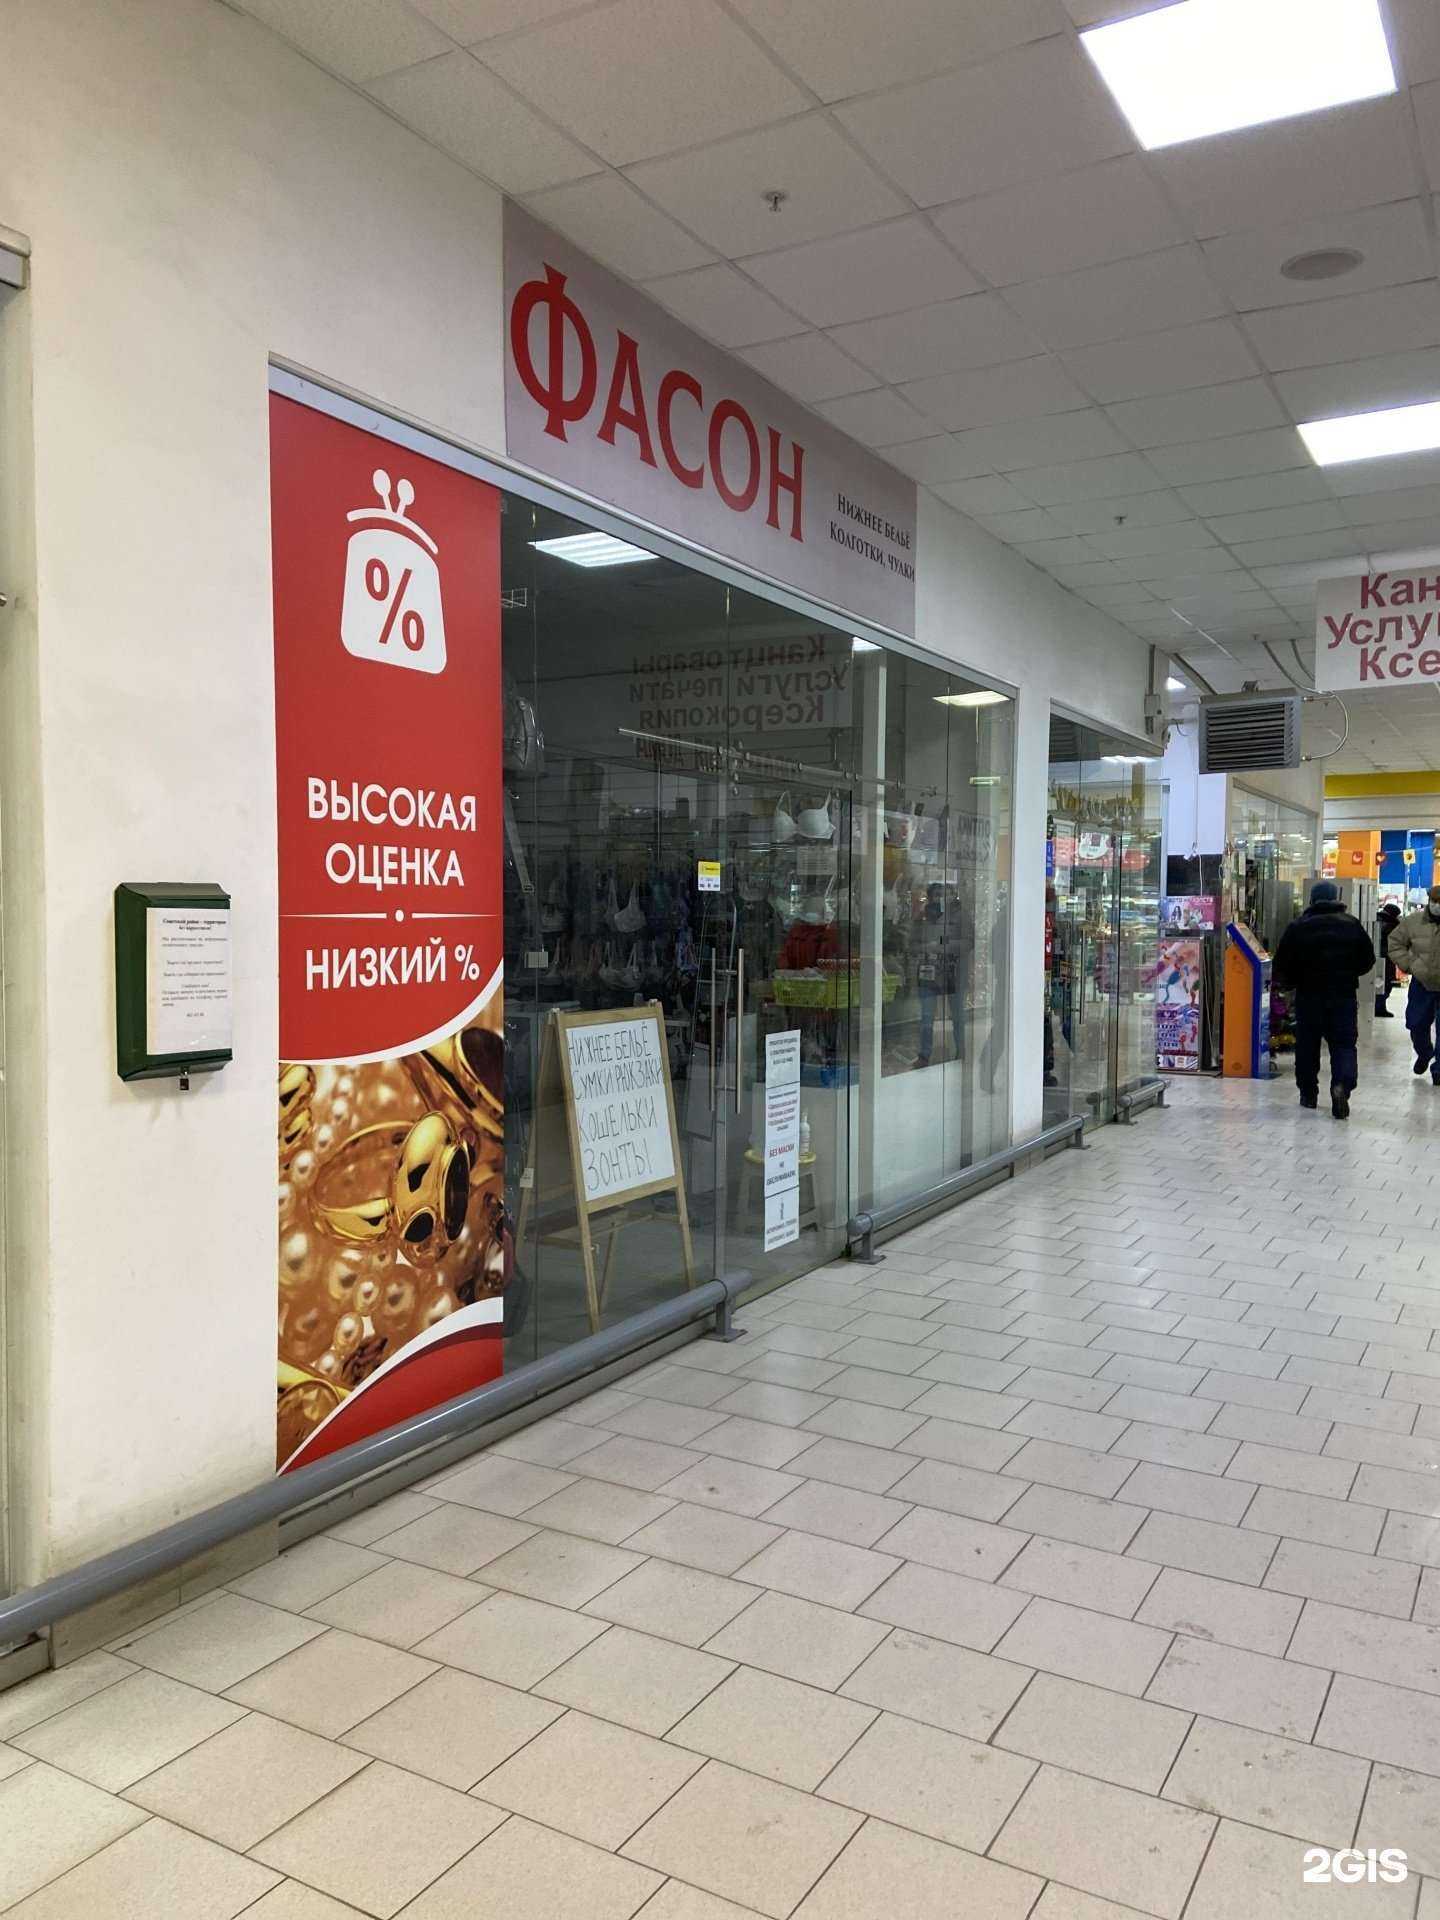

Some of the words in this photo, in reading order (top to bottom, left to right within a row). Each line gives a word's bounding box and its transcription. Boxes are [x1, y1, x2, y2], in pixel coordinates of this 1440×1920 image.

[510, 262, 805, 543] ФАСОН
[837, 492, 883, 534] НИЖНЕЕ
[829, 520, 886, 569] КОЛГОТКИ,
[887, 553, 915, 584] ЧУЛКИ
[1324, 612, 1440, 649] Услу
[1360, 646, 1440, 681] Ксе
[307, 776, 477, 832] ВЫСОКАЯ
[325, 842, 465, 891] ОЦЕНКА
[306, 937, 446, 990] НИЗКИЙ
[454, 945, 480, 981] %
[569, 1031, 613, 1066] НИЖНЕЕ
[579, 1096, 657, 1143] КОШЕЛЬКИ
[584, 1138, 652, 1191] ЗОНТЫ
